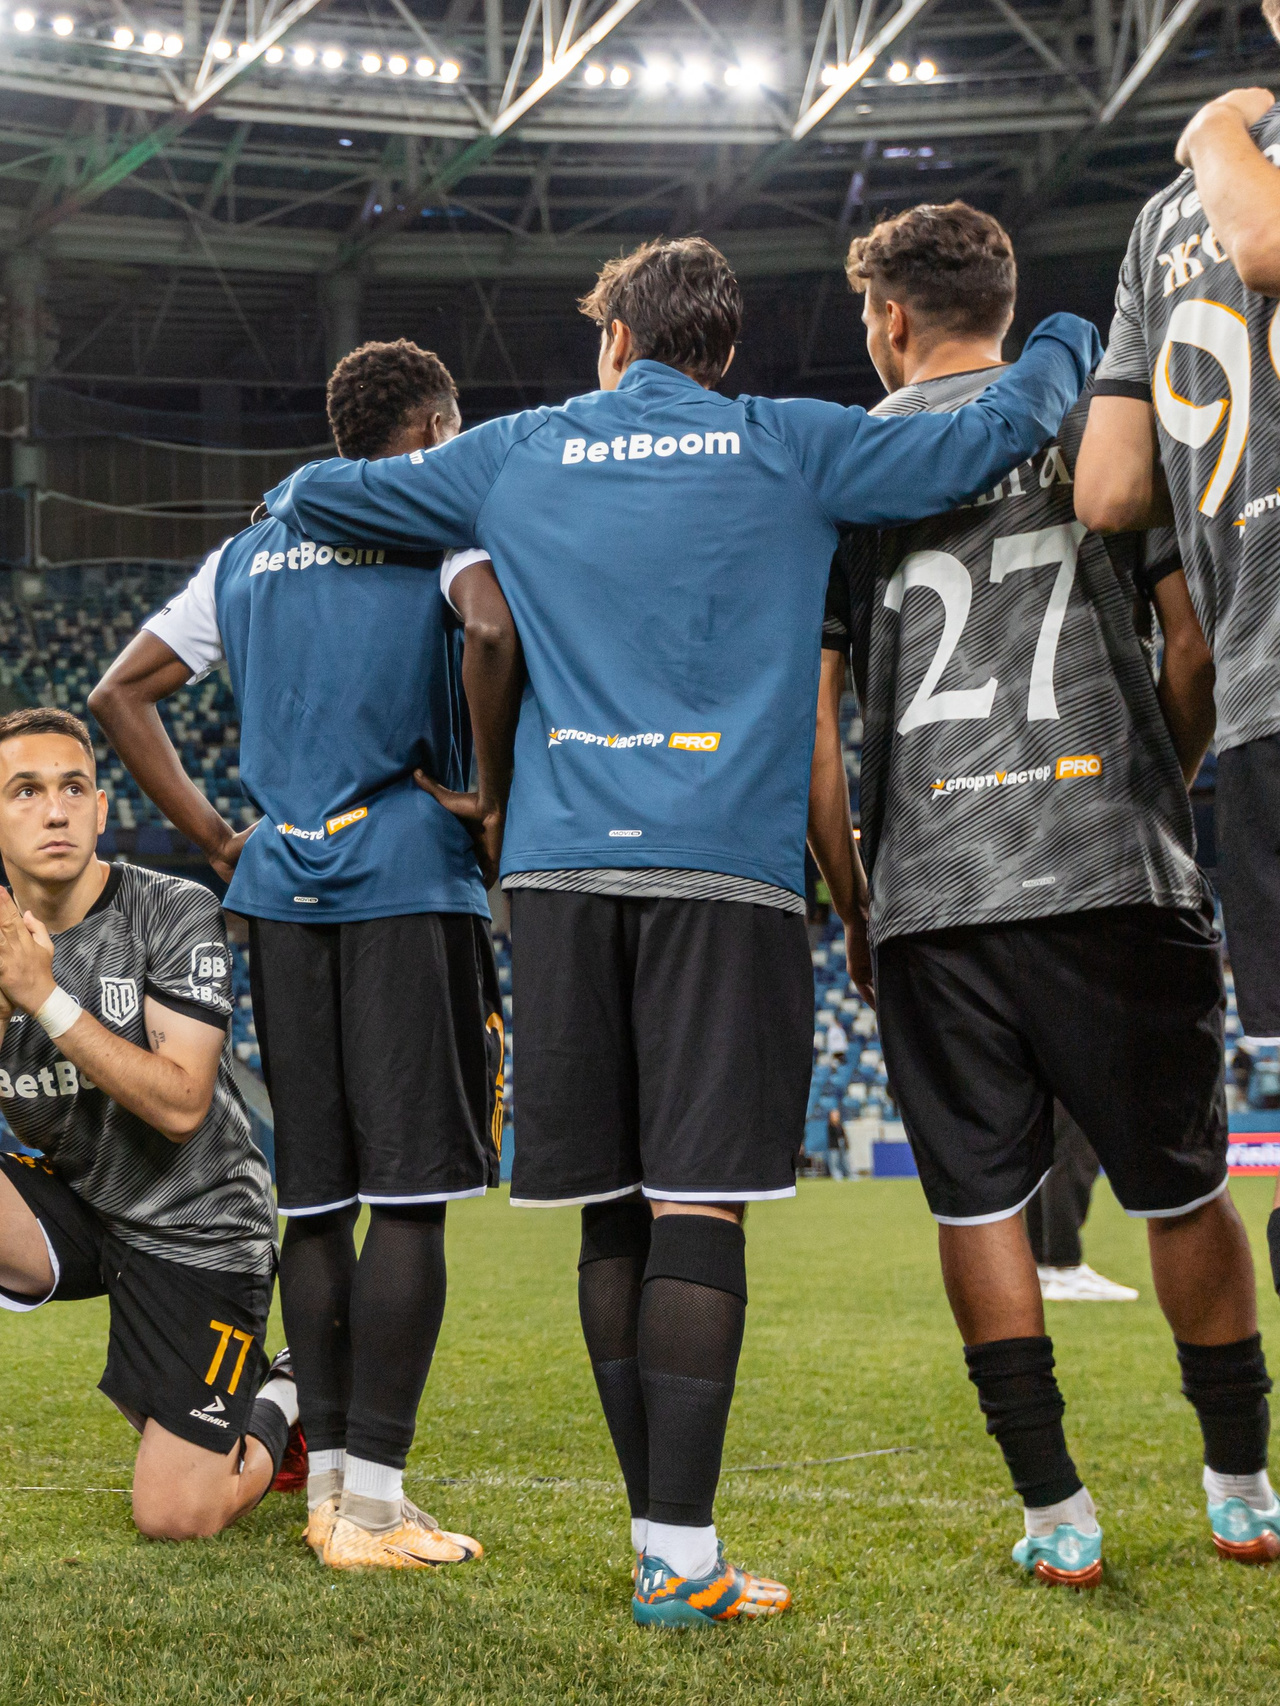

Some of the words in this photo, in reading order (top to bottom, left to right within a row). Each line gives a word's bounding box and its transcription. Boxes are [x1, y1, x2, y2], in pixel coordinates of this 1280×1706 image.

[562, 431, 740, 465] BetBoom
[249, 541, 385, 577] BetBoom
[883, 521, 1089, 736] 27
[671, 734, 719, 750] PRO
[1058, 757, 1101, 778] PRO
[328, 808, 366, 833] PRO
[198, 956, 227, 978] BB
[204, 1319, 255, 1396] 77
[189, 1408, 230, 1429] DEMIX
